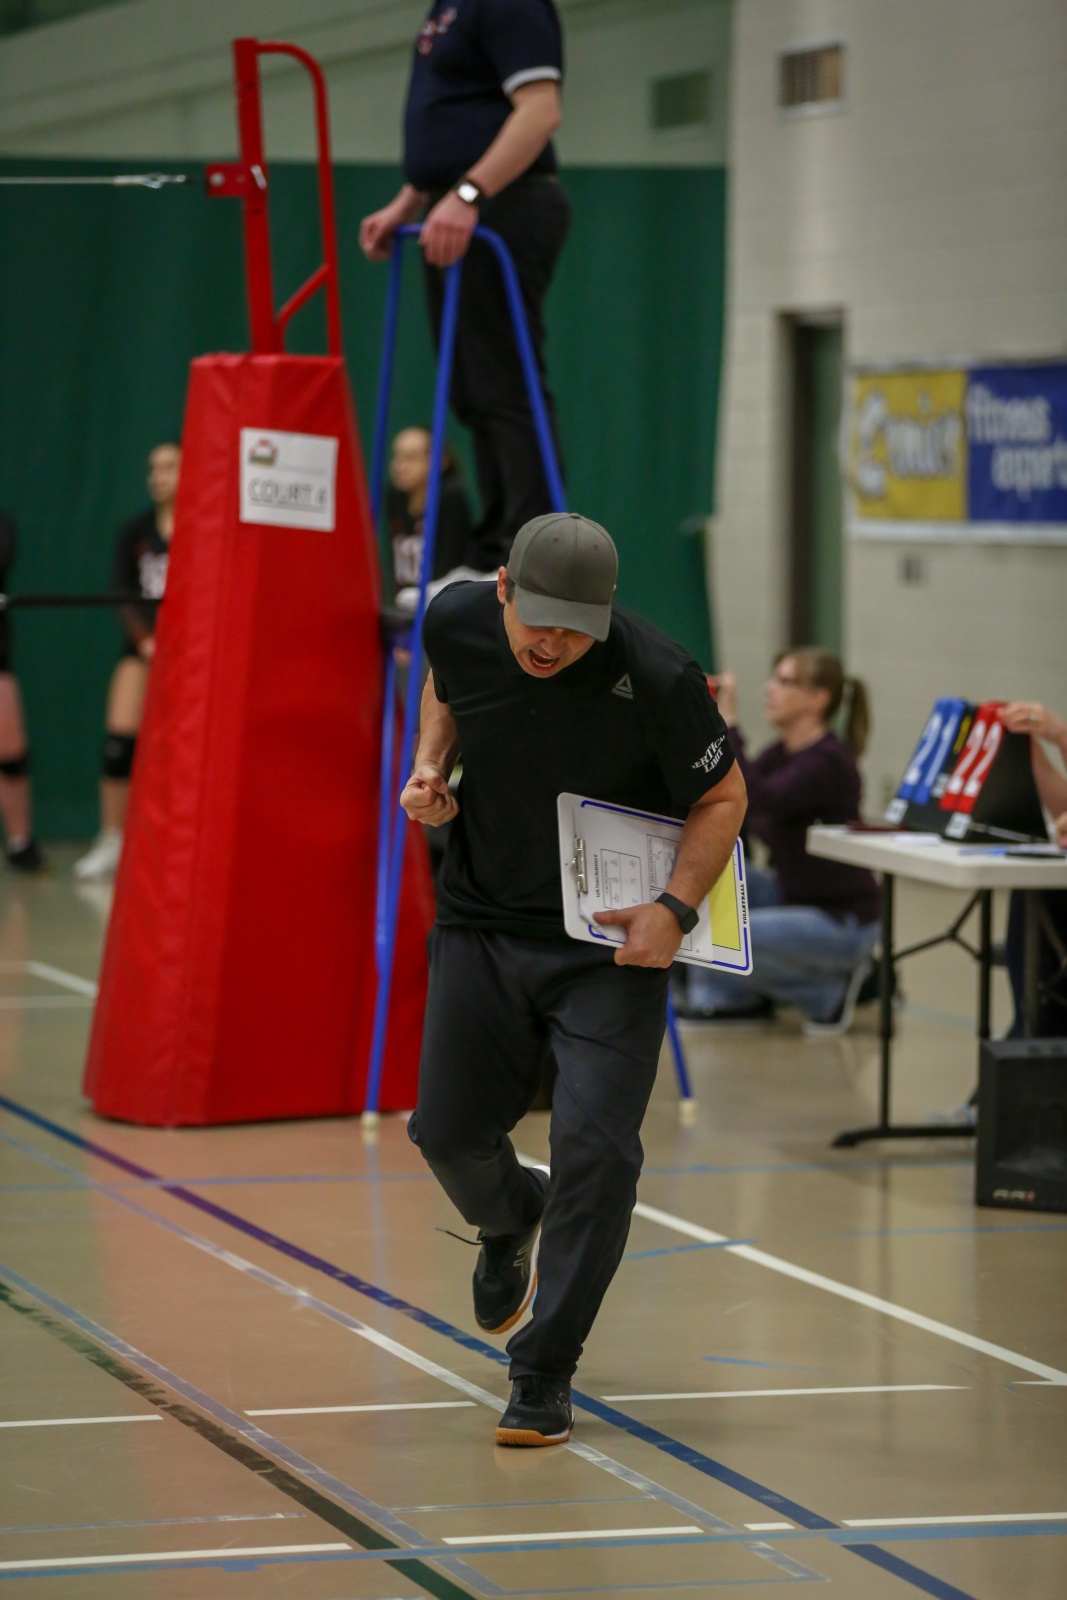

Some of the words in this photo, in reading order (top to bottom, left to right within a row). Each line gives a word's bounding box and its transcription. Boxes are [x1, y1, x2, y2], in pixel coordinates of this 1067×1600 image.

[248, 478, 312, 504] COURT
[947, 720, 1001, 797] 22
[740, 883, 748, 925] VOLLEYBALL
